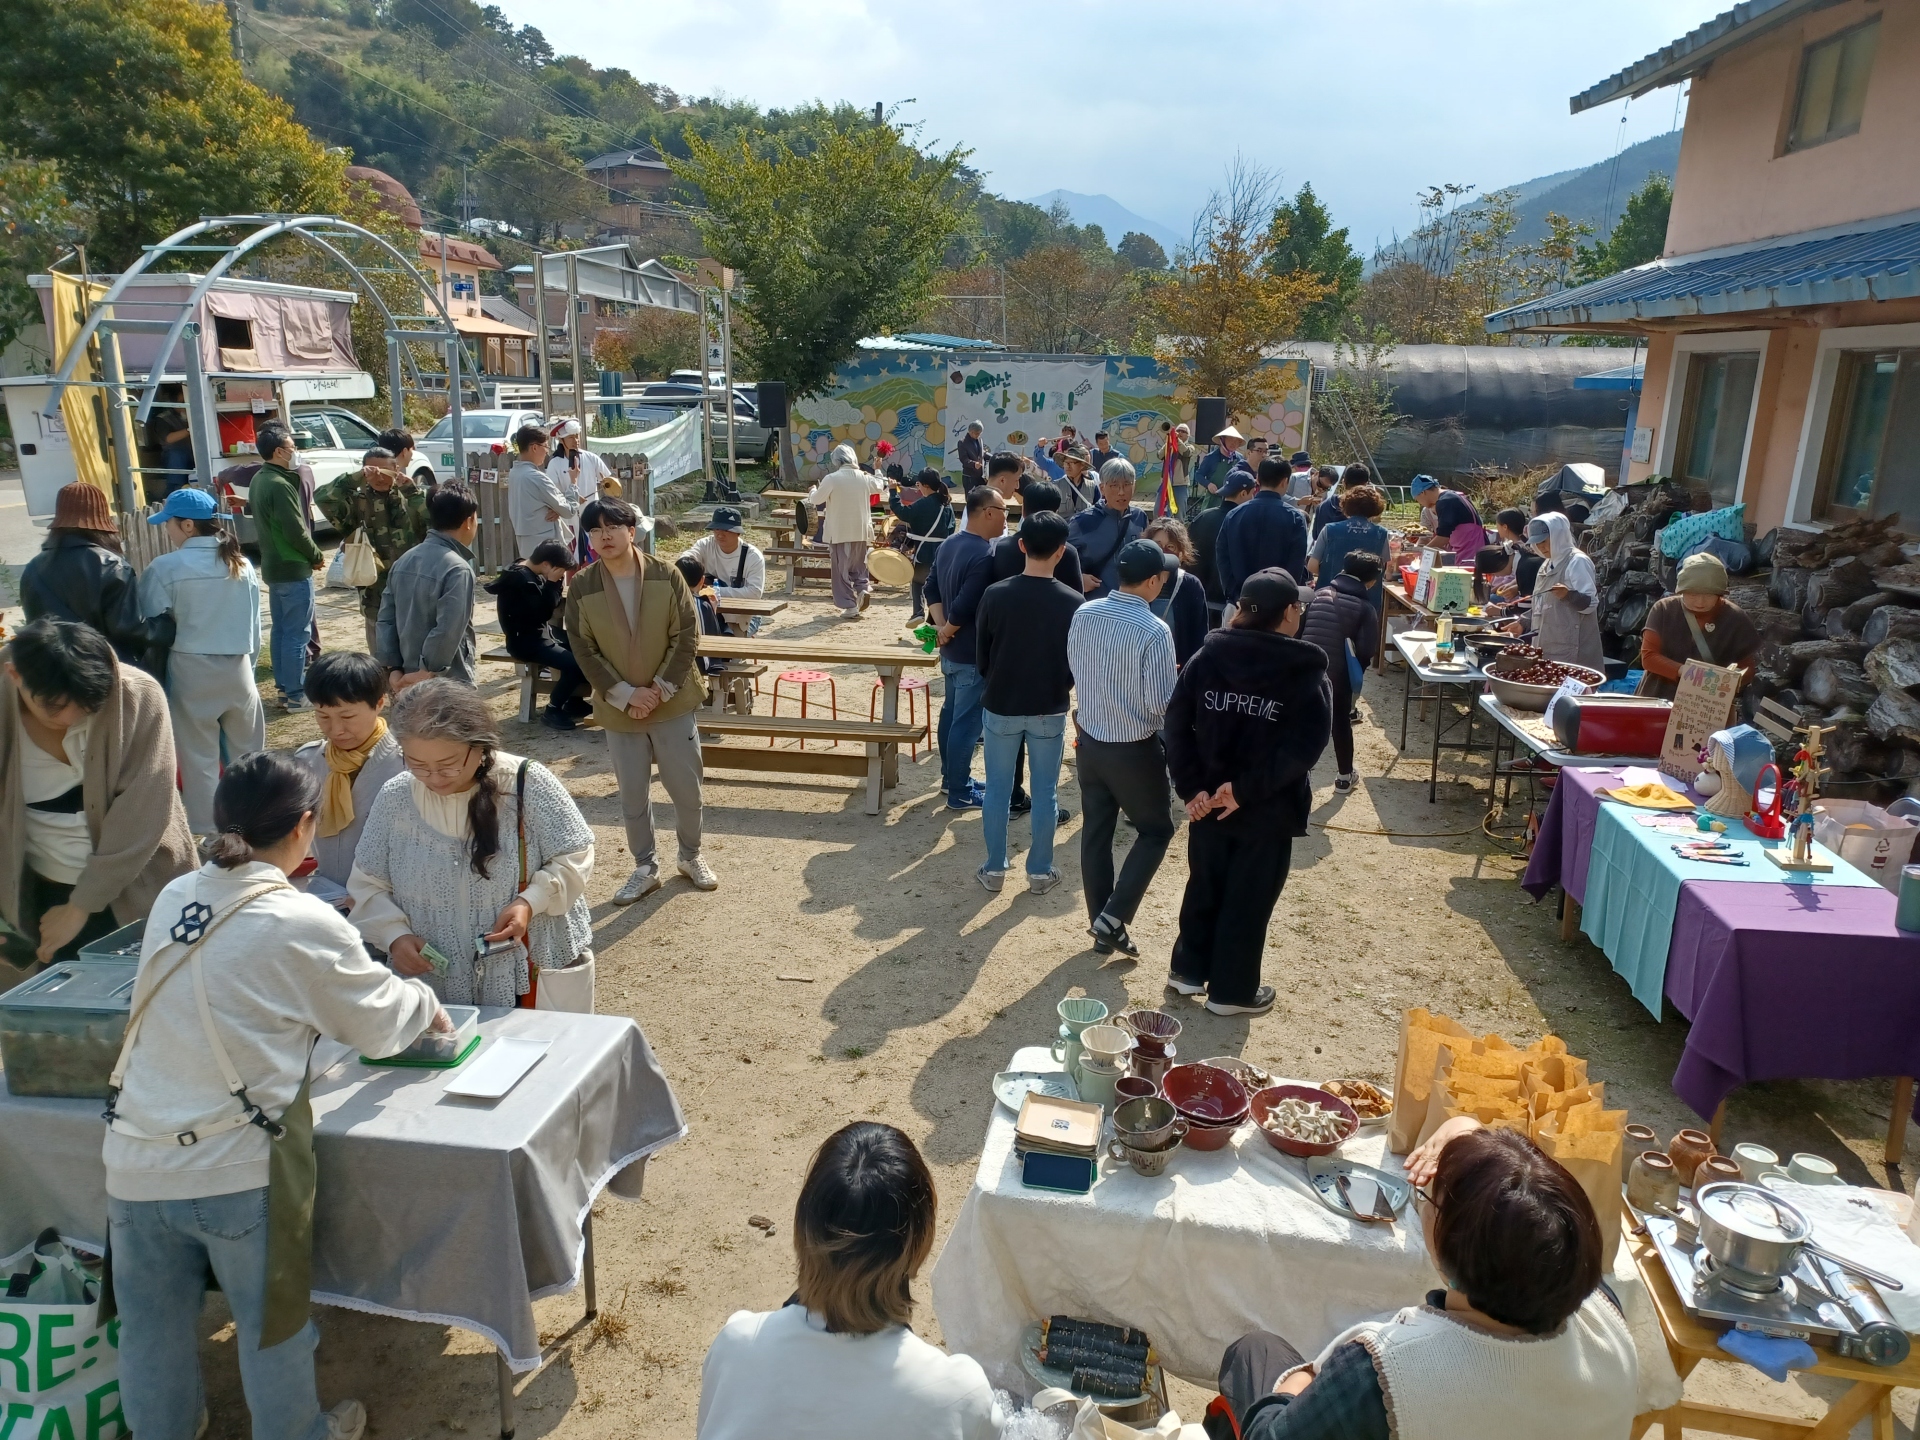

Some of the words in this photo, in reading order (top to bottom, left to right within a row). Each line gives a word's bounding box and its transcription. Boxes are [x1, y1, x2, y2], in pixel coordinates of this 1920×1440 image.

[969, 371, 1012, 397] 지리산
[1684, 665, 1731, 698] 새활용
[1204, 690, 1284, 722] SUPREME
[0, 1379, 132, 1440] TAR
